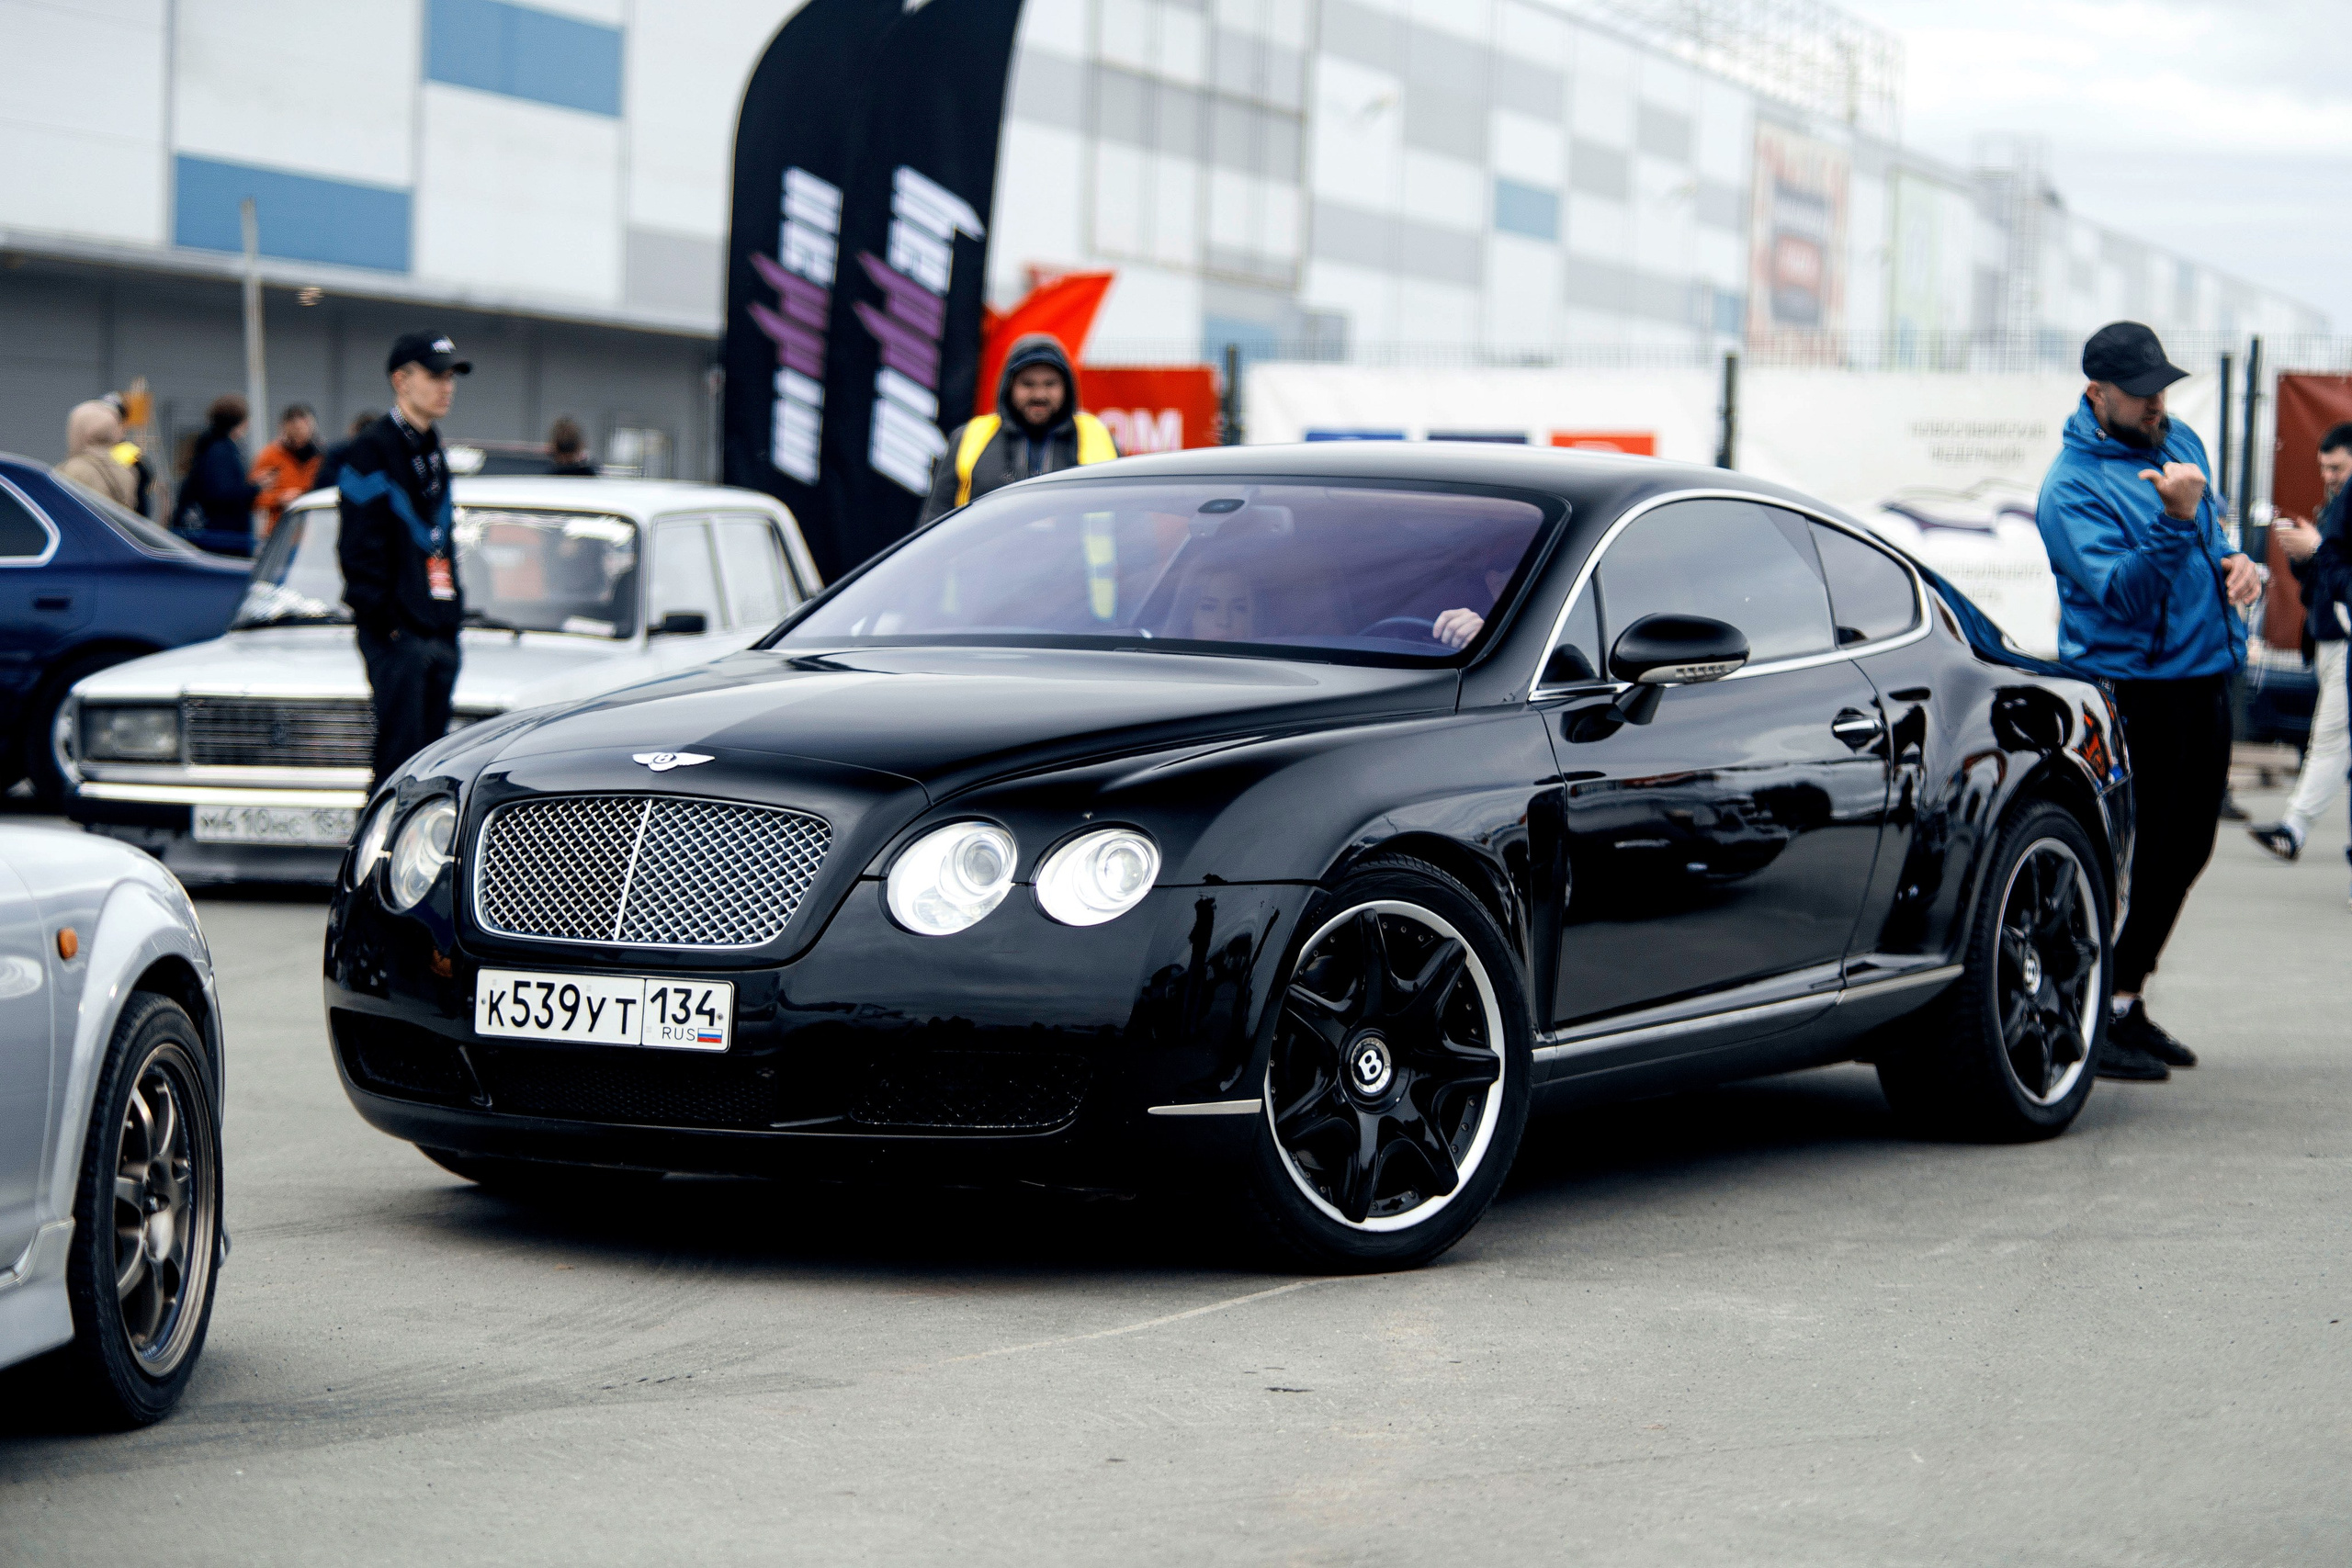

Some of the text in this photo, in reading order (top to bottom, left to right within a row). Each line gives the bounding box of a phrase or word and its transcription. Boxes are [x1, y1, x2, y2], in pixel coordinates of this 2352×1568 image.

[650, 987, 716, 1027] 134
[662, 1026, 695, 1042] RUS
[1358, 1049, 1383, 1080] B
